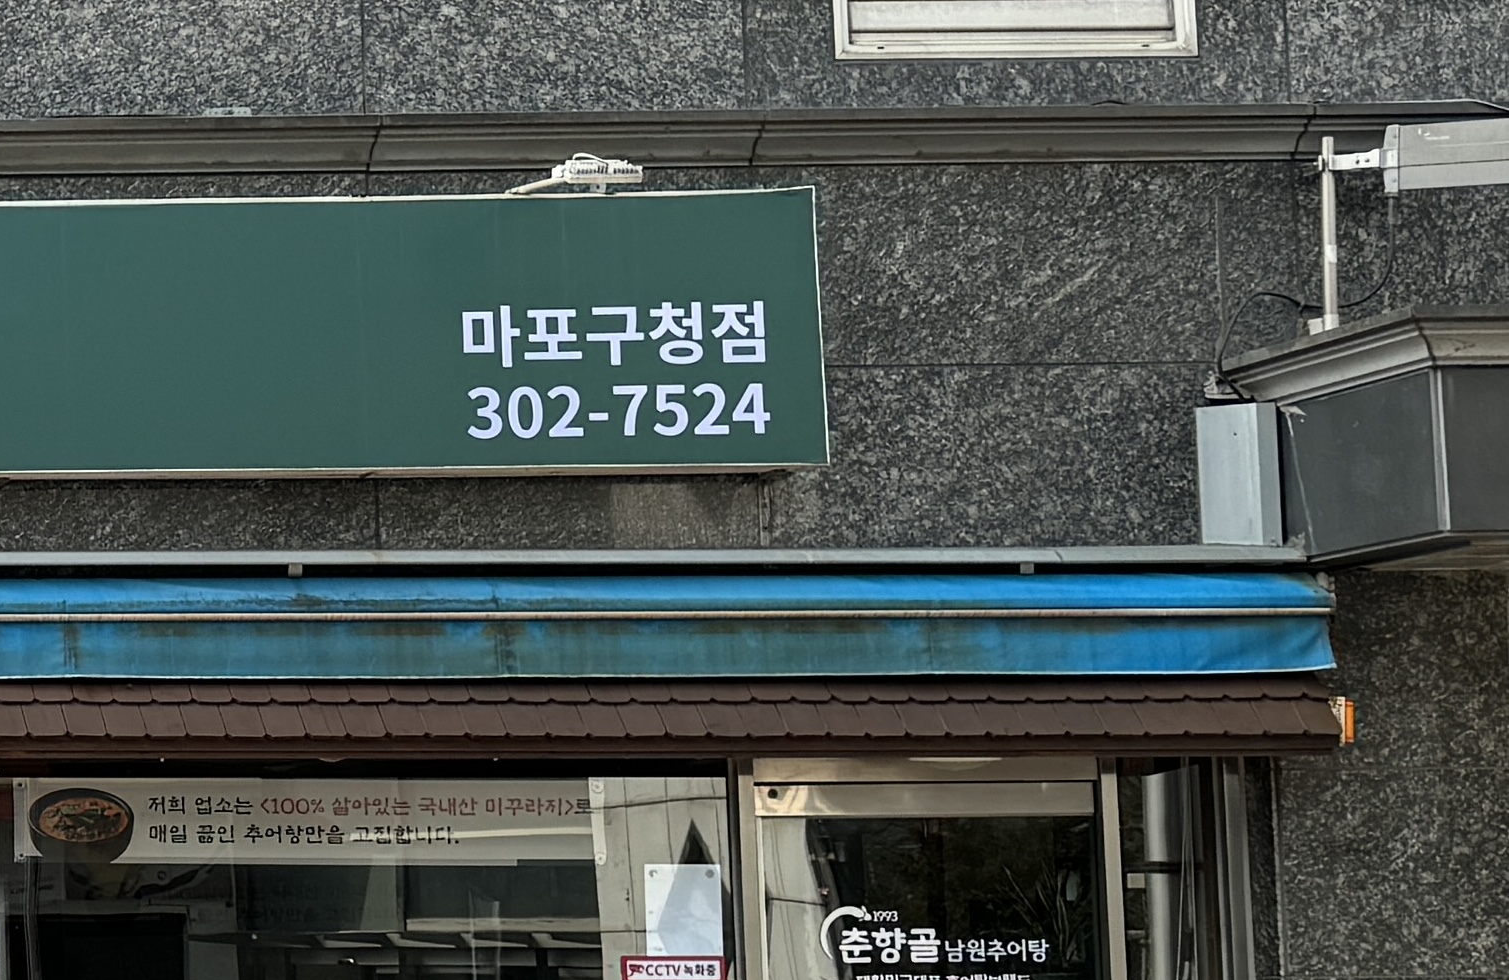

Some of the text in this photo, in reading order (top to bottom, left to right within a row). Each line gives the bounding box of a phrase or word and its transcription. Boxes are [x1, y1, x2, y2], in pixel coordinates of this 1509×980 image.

[462, 301, 767, 368] 마포구청점
[467, 382, 771, 439] 302-7524
[148, 796, 186, 815] 저희
[195, 796, 253, 815] 업소는
[260, 797, 325, 815] <100%
[333, 797, 411, 816] 살아있는
[418, 797, 478, 816] 국내산
[149, 824, 460, 845] 매일 끓인 추어탕만을 고집합니다.
[872, 910, 898, 922] 1993
[839, 927, 1050, 964] 춘향골 남원추어탕
[646, 964, 681, 976] CCTV
